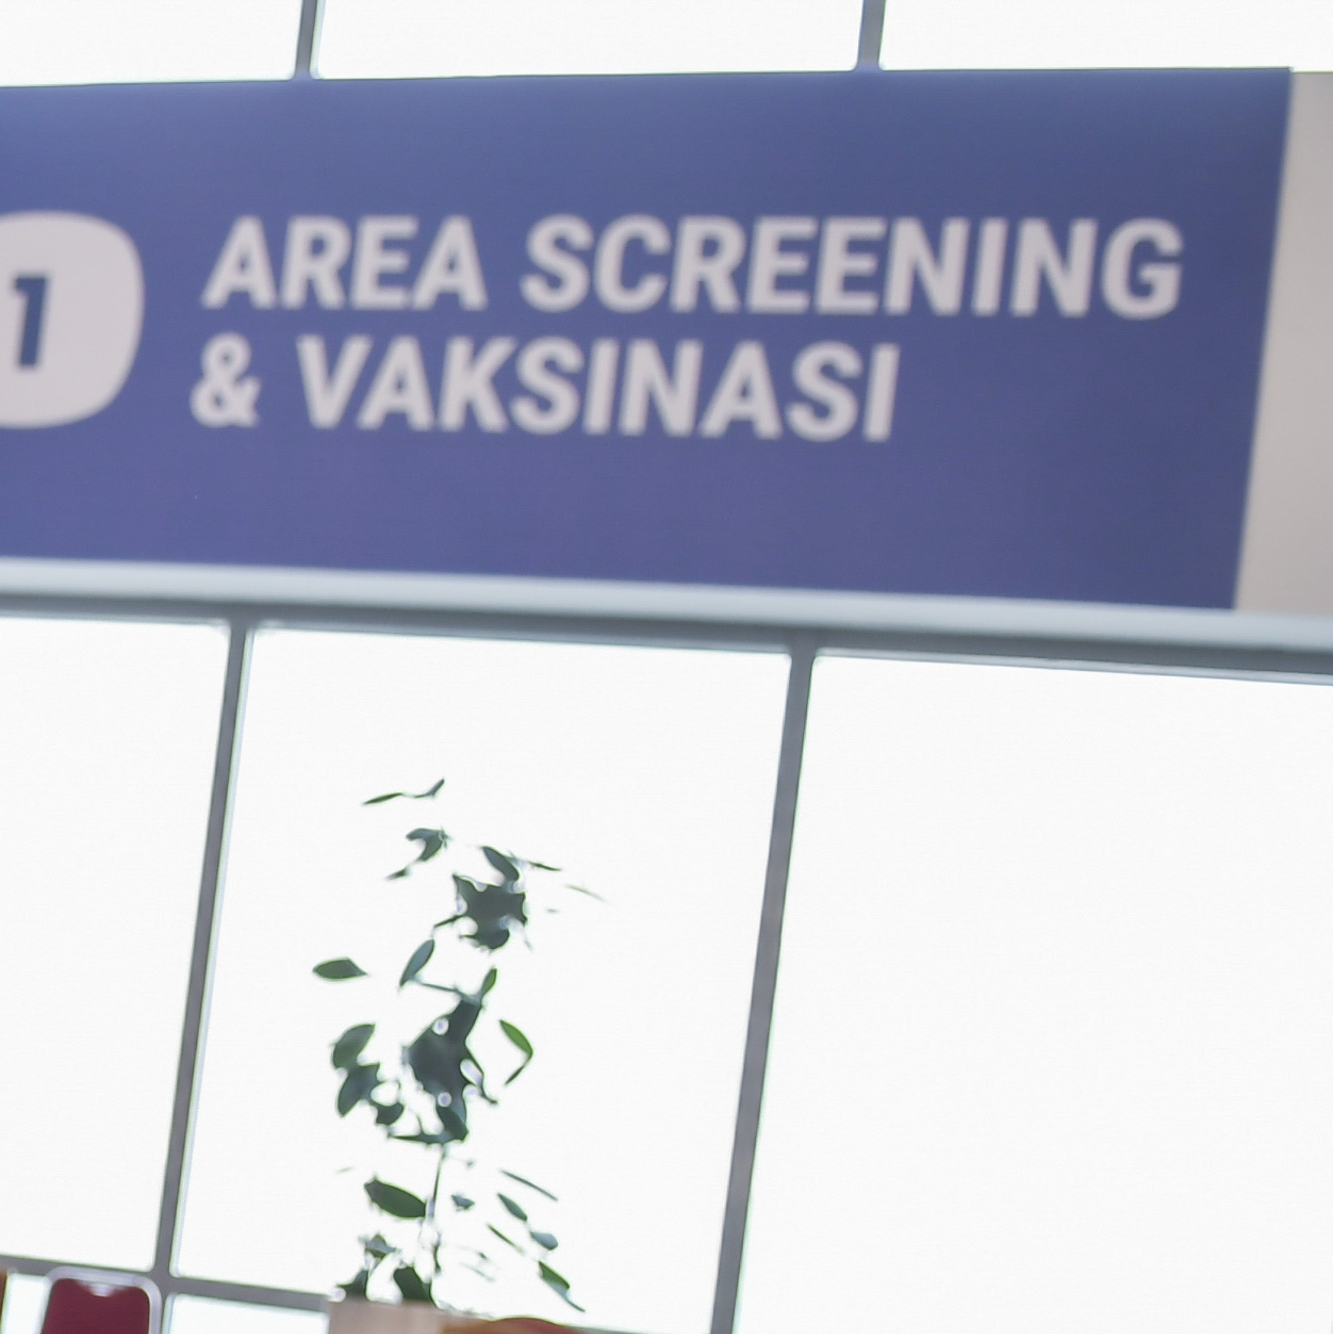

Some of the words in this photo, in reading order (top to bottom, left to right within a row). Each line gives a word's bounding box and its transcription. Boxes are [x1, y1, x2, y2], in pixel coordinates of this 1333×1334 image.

[201, 214, 489, 312] AREA
[520, 213, 1183, 319] SCREENING
[11, 272, 50, 370] 1
[189, 331, 262, 429] &
[295, 333, 901, 442] VAKSINASI
